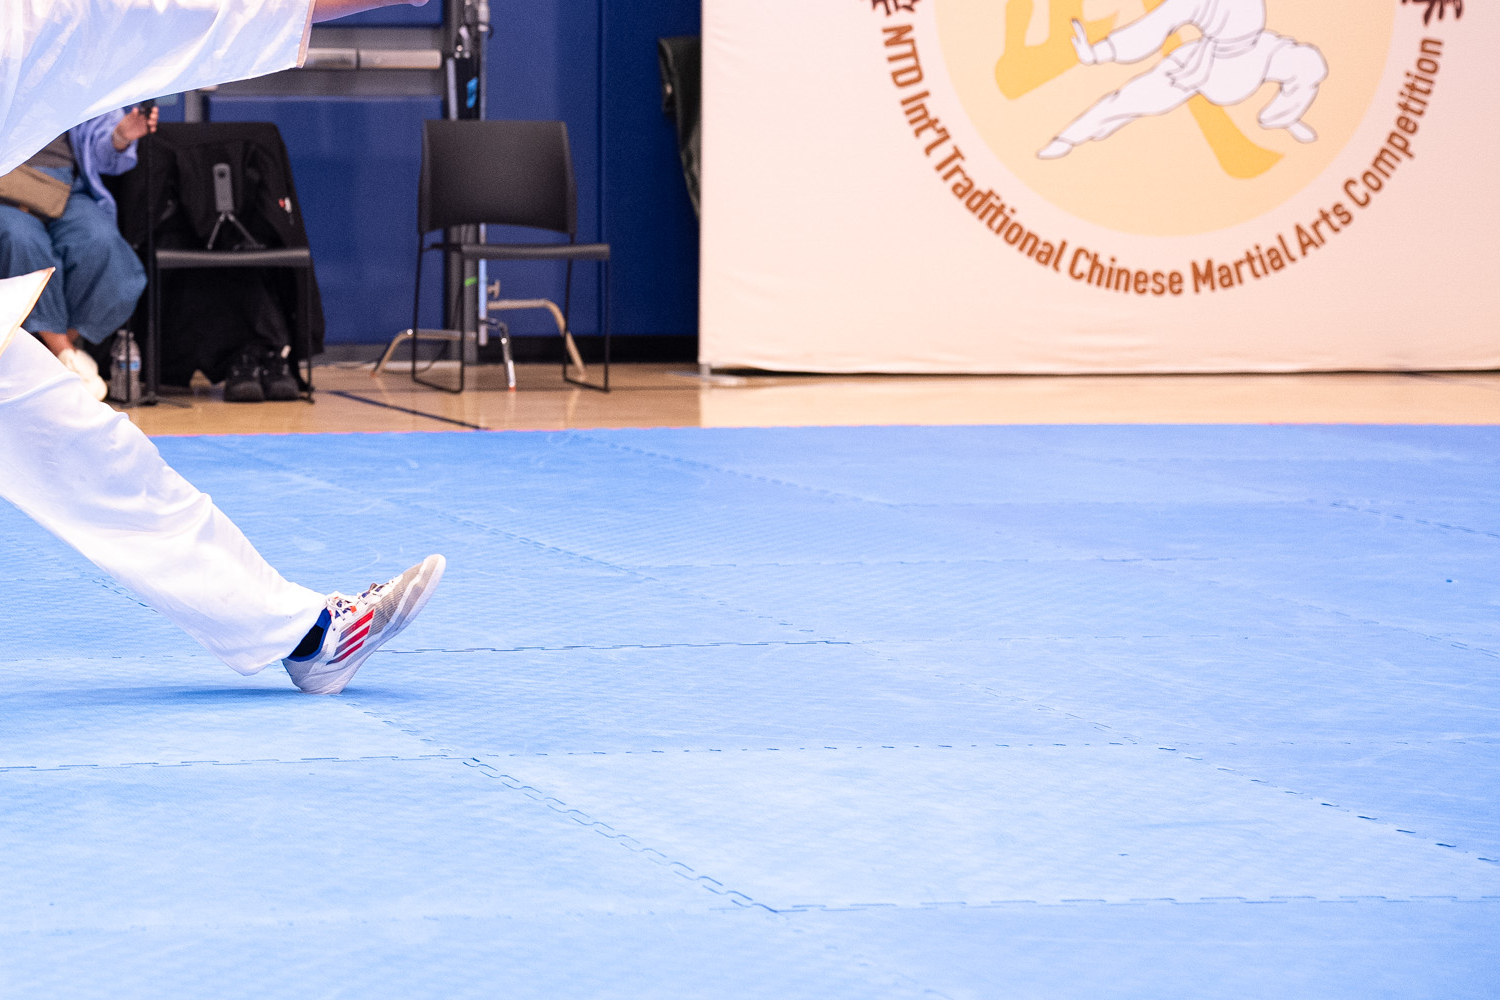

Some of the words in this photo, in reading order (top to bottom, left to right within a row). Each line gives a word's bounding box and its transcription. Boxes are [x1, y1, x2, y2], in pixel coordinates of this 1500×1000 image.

[881, 24, 924, 89] NTD
[934, 144, 1068, 273] Traditional
[1068, 246, 1184, 297] Chinese
[1190, 232, 1298, 295] Martial
[1294, 201, 1354, 258] Arts
[1342, 36, 1445, 208] Competition
